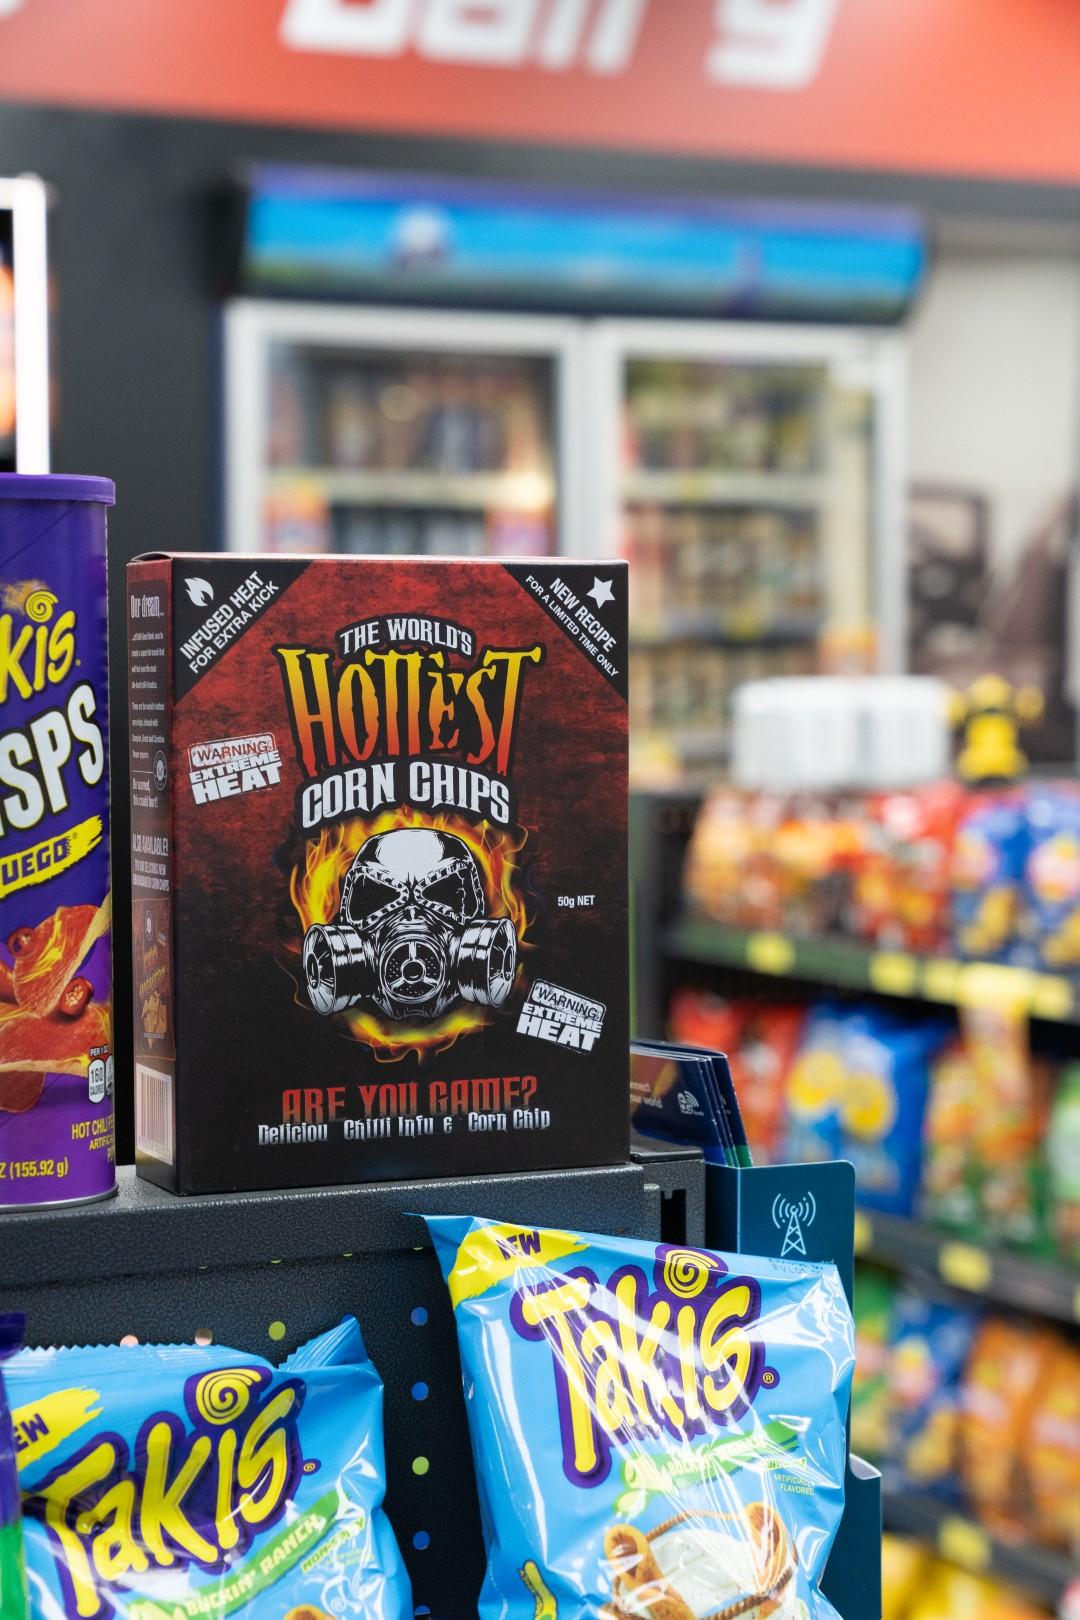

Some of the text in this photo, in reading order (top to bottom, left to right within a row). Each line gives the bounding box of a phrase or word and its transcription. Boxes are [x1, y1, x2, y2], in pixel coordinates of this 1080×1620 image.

[179, 570, 265, 660] INFUSED HEAT
[189, 580, 280, 674] FOR EXTRA KICK
[525, 574, 620, 677] FOR A LIMITED TIME ONLY
[549, 577, 617, 652] NEW RECIPE
[339, 617, 473, 656] THE WORLD'S
[189, 749, 281, 785] EXTREME
[191, 761, 283, 805] HEAT
[302, 761, 510, 829] CORN CHIPS
[557, 894, 596, 909] 50g NET
[516, 1012, 601, 1052] HEAT
[522, 1002, 603, 1033] EXTREME
[282, 1086, 346, 1124] ARE
[359, 1081, 418, 1120] YOU
[467, 1109, 507, 1133] Corn
[72, 1121, 91, 1140] HOT
[10, 1160, 54, 1180] (155.92
[57, 1156, 68, 1178] g)
[259, 1514, 328, 1575] RANCH
